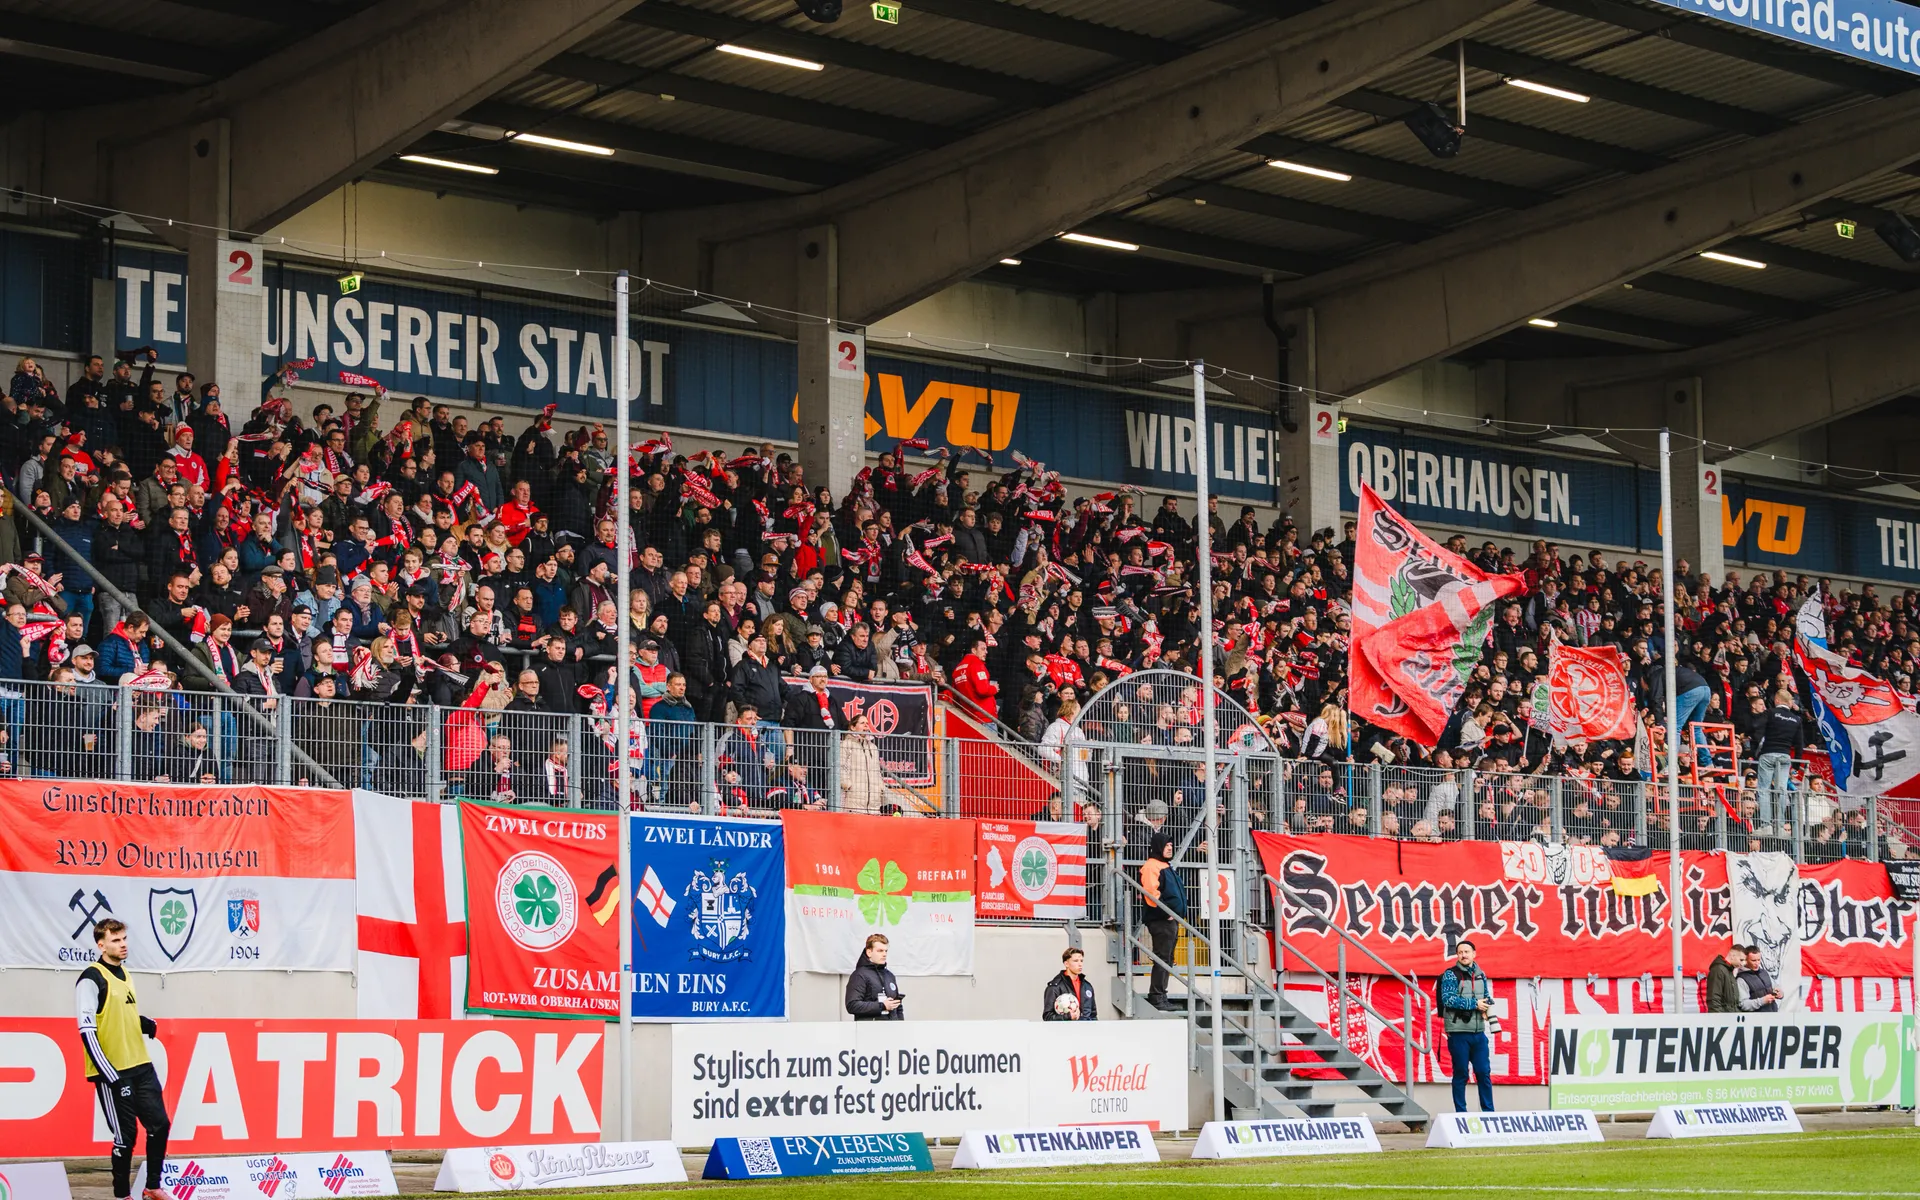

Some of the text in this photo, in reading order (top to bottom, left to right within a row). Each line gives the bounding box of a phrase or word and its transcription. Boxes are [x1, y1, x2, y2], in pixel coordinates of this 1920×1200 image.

[228, 250, 253, 285] 2
[117, 265, 670, 406] TE UNSERER STADT
[838, 340, 857, 372] 2
[1317, 411, 1333, 439] 2
[1125, 408, 1581, 527] WIR LIE OBERHAUSEN.
[1704, 470, 1718, 495] 2
[42, 786, 270, 819] Emscherkameraden
[485, 814, 607, 841] ZWEI CLUBS
[644, 825, 773, 849] ZWEI LÄNDER
[54, 838, 260, 873] RW Oberhausen
[815, 863, 841, 877] 1904
[917, 869, 967, 881] GREFRATH
[821, 886, 839, 898] RWO
[931, 892, 947, 903] RWO
[981, 892, 1005, 901] FANCLUB
[802, 906, 855, 921] GREFRATH
[1281, 850, 1543, 960] Semper
[510, 921, 526, 938] SC
[929, 912, 954, 924] 1904
[58, 947, 97, 963] Glück
[229, 946, 260, 961] 1904
[702, 947, 721, 960] BURY
[533, 967, 727, 995] ZUSAMEN EINS
[483, 991, 619, 1011] ROT-WEIß OBERHAUSEN
[691, 1000, 751, 1013] BURY A.F.C.
[1552, 1016, 1842, 1077] NOTTENKÄMPER
[693, 1048, 1021, 1088] Stylisch zum Sieg! Die Daumen
[1067, 1055, 1150, 1092] Westfield
[93, 1031, 604, 1142] ATRICK
[120, 1085, 131, 1097] 25
[1557, 1090, 1678, 1106] Entsorgungsfachbetrieb
[1714, 1088, 1728, 1100] 56
[1808, 1084, 1834, 1097] KrWG
[693, 1084, 982, 1122] sind extra fest gedrückt.
[1091, 1097, 1128, 1113] CENTRO
[1674, 1104, 1788, 1125] NOTTENKÄMPER
[1224, 1119, 1364, 1144] NOTTENKÄMPER
[1455, 1111, 1588, 1134] NOTTENKÄMPER
[985, 1127, 1141, 1154] NOTTENKÄMPER
[246, 1157, 275, 1169] UGRO
[837, 1154, 914, 1165] ZUKUNFTSSCHMIEDE
